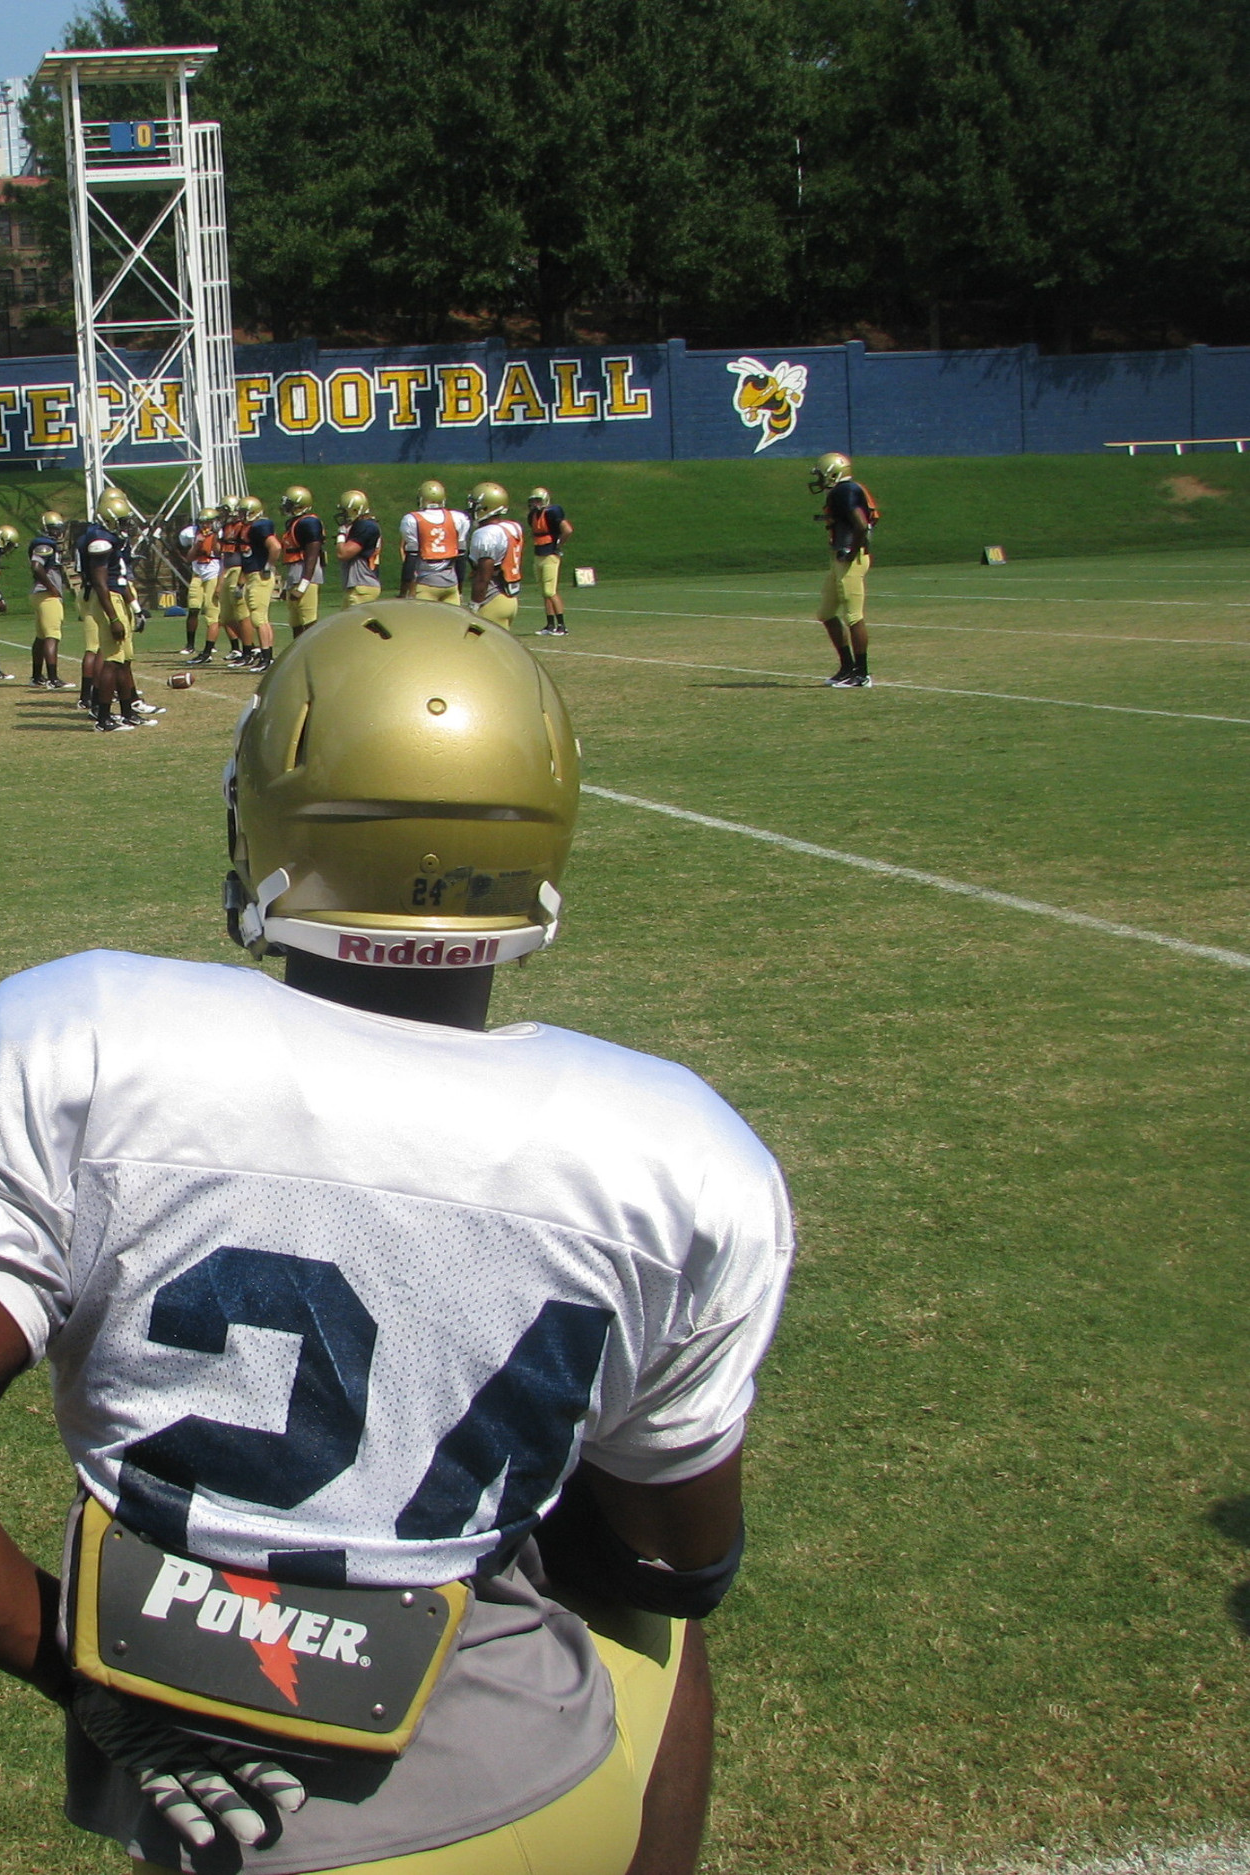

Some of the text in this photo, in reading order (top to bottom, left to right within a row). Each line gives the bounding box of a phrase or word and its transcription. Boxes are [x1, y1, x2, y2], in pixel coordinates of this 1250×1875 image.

[235, 356, 652, 439] FOOTBALL
[430, 527, 447, 553] 2
[159, 593, 175, 607] 40
[412, 879, 444, 905] 24
[339, 932, 500, 966] Riddell
